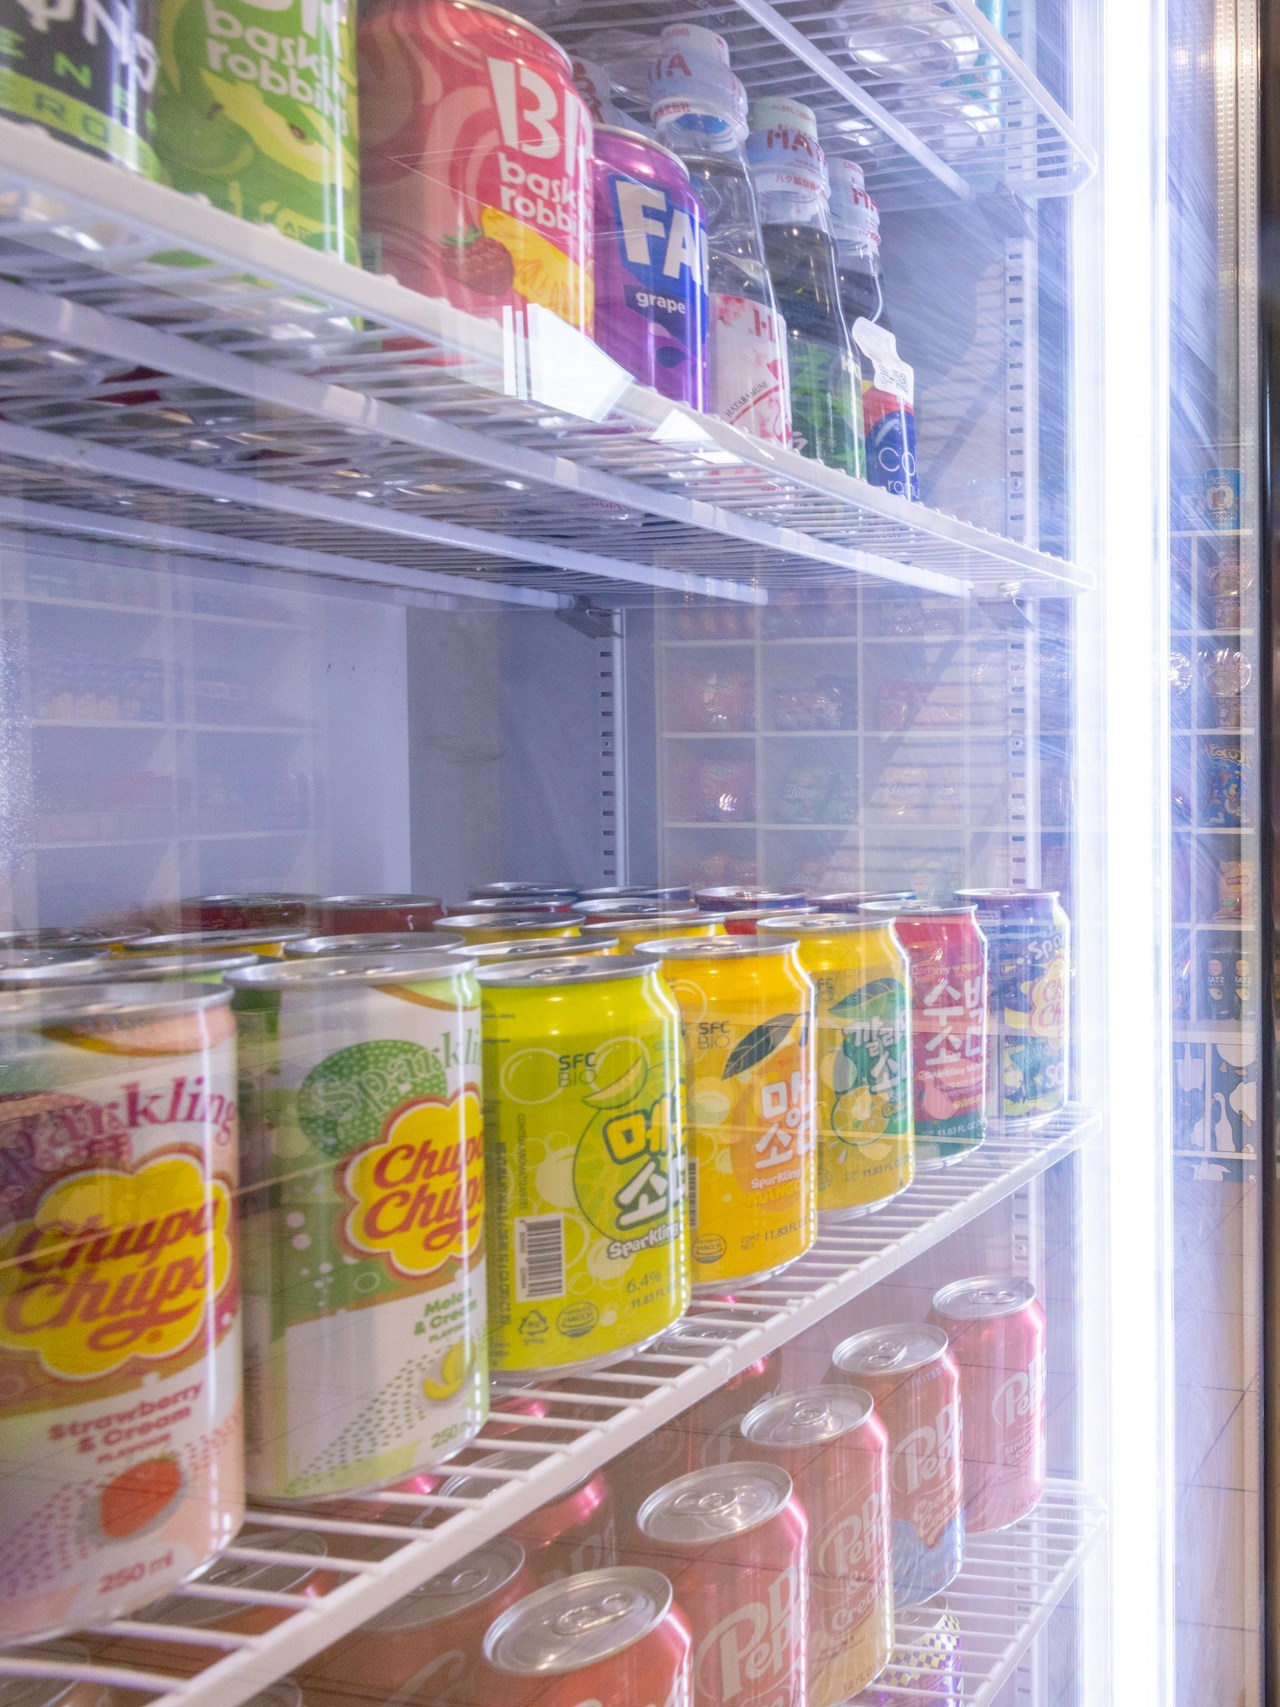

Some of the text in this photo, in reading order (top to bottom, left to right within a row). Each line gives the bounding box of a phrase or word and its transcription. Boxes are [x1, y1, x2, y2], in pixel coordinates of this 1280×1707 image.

[635, 291, 686, 315] grape
[725, 381, 768, 418] HATARAMUNE
[698, 1020, 731, 1035] SFC
[697, 1034, 731, 1051] BIO
[557, 1051, 597, 1071] SFC
[557, 1066, 598, 1088] BIO
[751, 1167, 802, 1189] Sparkling
[14, 1196, 221, 1276] Chupa
[605, 1219, 681, 1260] Sparkling
[625, 1266, 662, 1293] 6.4%
[0, 1244, 213, 1353] Chups
[413, 1320, 426, 1336] &
[48, 1380, 205, 1442] Strawberry
[77, 1404, 194, 1456] & Cream
[429, 1424, 459, 1448] 250
[98, 1551, 175, 1596] 250 ml
